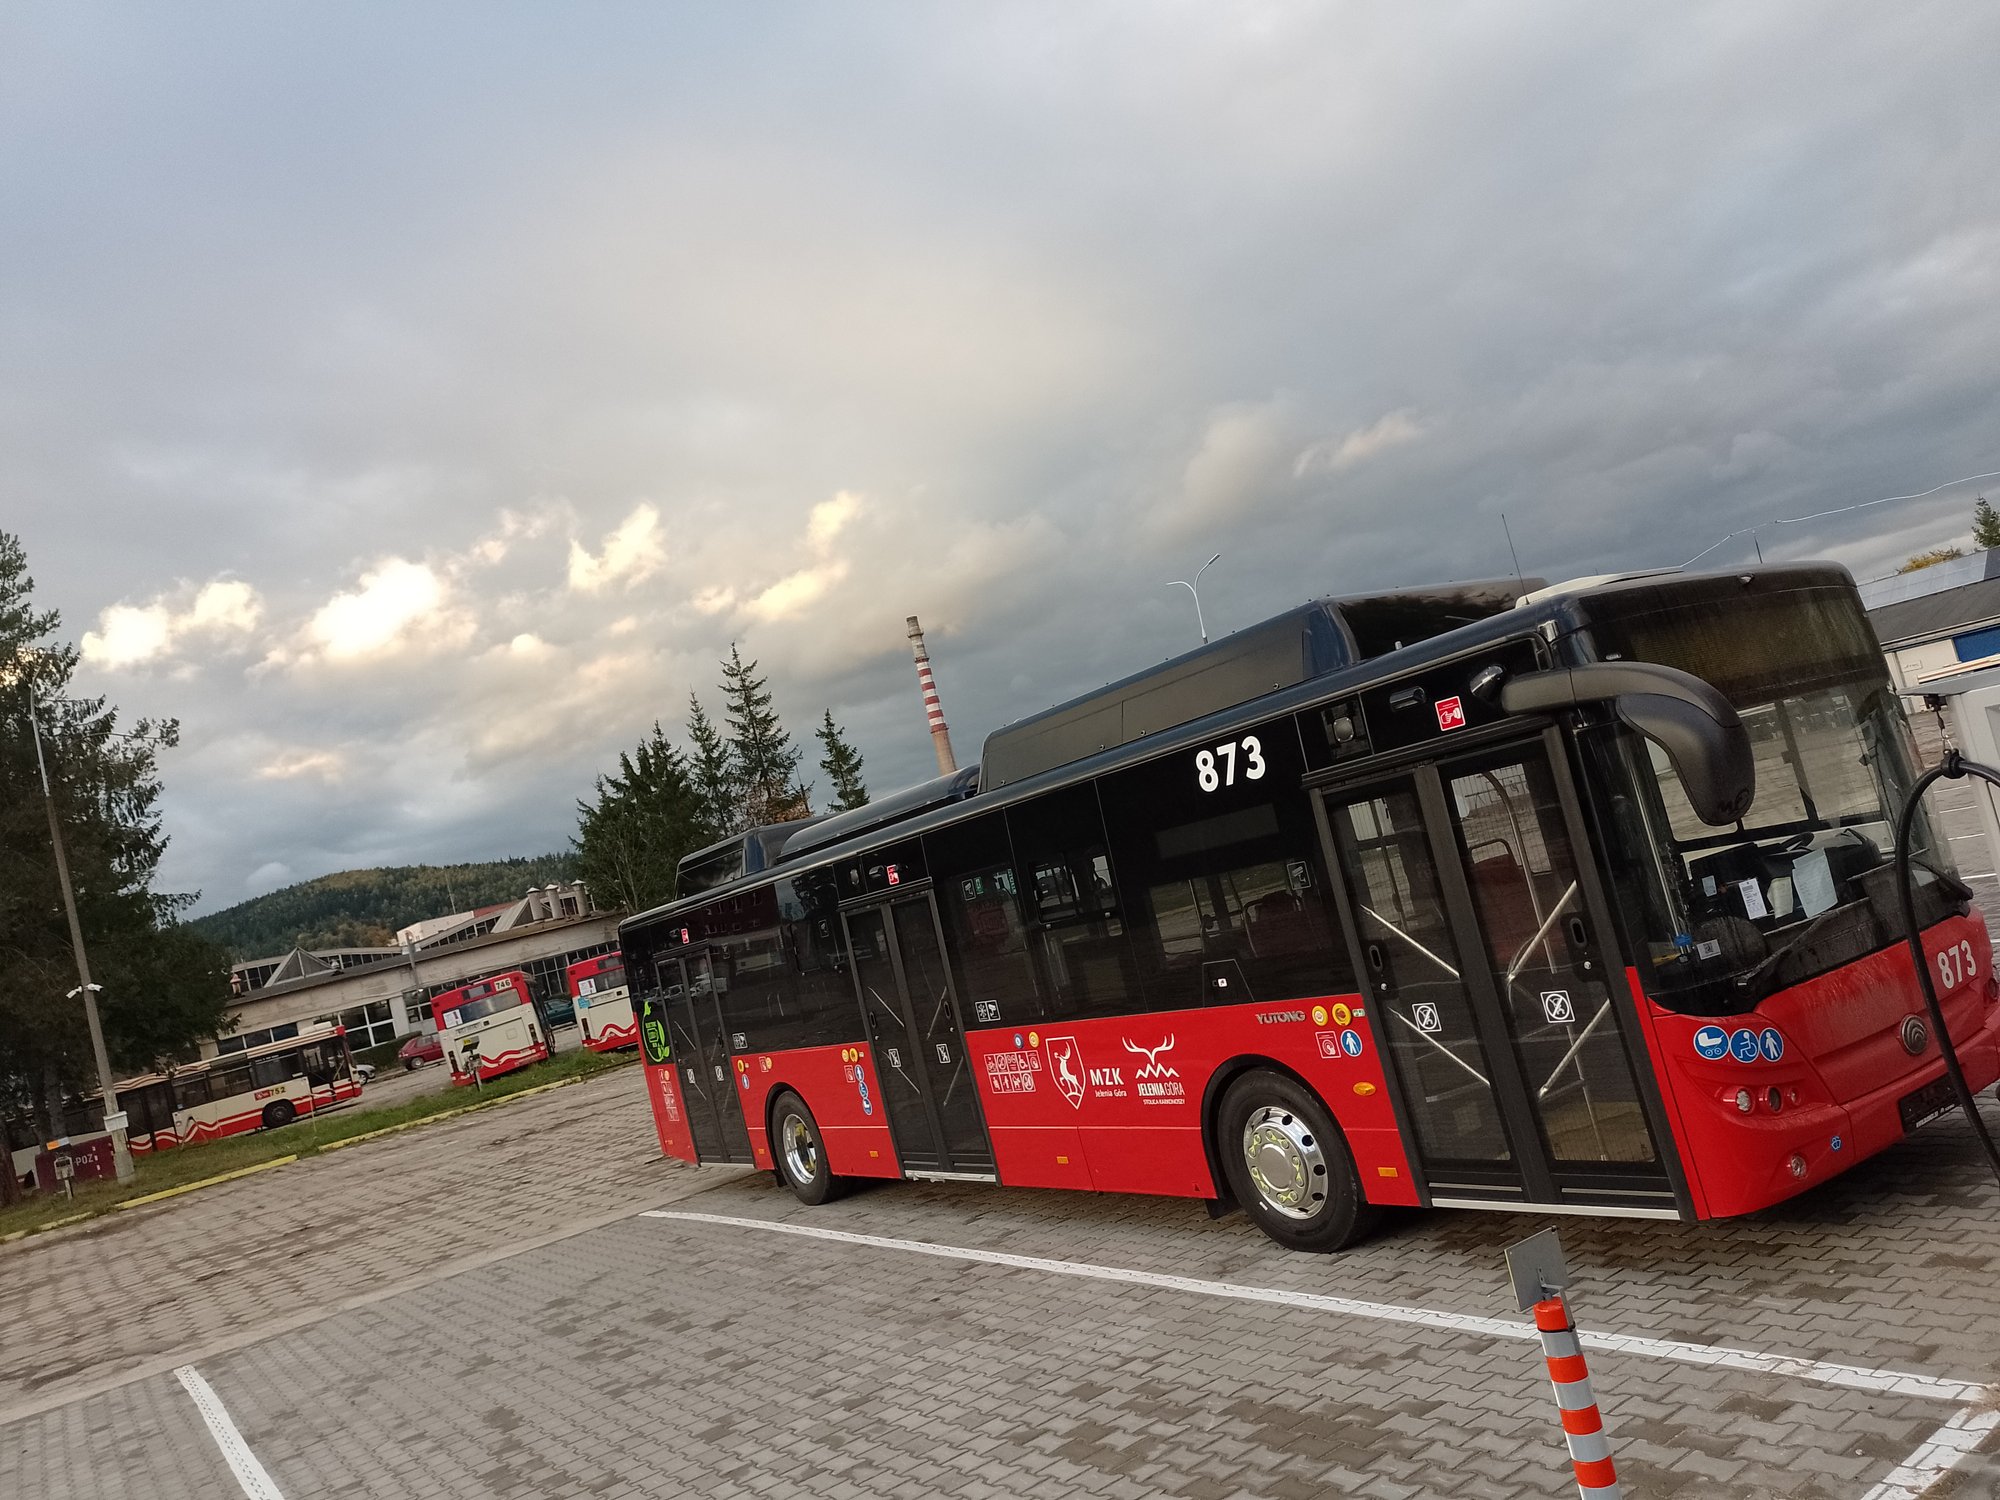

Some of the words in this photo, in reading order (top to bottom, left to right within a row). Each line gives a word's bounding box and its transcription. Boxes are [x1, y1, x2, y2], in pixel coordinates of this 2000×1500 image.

[1195, 735, 1266, 792] 873
[1937, 939, 1977, 989] 873
[495, 979, 511, 990] 746
[1255, 1010, 1306, 1024] YUTONG
[1089, 1068, 1124, 1086] MZK
[270, 1086, 287, 1097] 752
[1094, 1089, 1113, 1098] Jelenia
[1113, 1088, 1128, 1097] Góra
[1137, 1082, 1165, 1097] JELENIA
[1164, 1081, 1185, 1096] GÓRA
